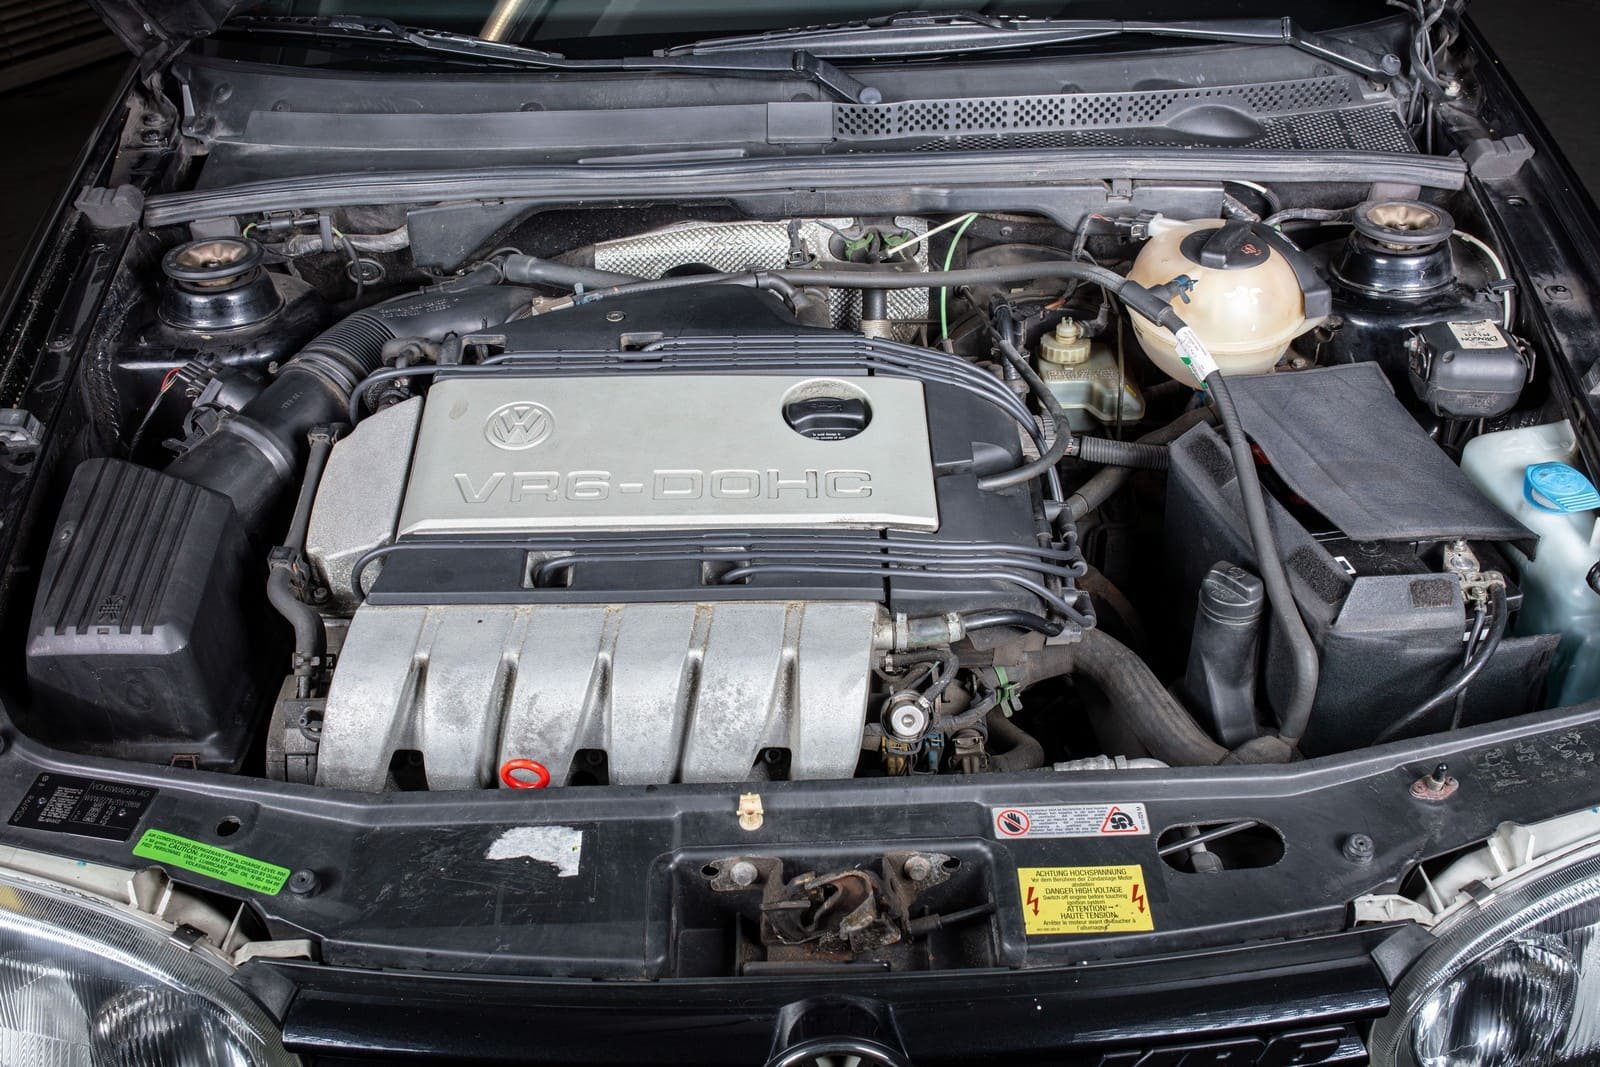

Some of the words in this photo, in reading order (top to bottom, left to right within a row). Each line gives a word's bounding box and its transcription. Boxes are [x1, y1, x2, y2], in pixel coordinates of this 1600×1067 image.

[453, 469, 873, 503] VR6-DOHC
[155, 834, 190, 847] CONDITIONING
[191, 844, 224, 857] REFRIGERANT
[240, 859, 260, 869] CHARGE
[260, 865, 276, 873] LEVEL
[185, 860, 219, 873] VOLKSWAGEN
[199, 852, 220, 862] SYSTEM
[234, 863, 258, 874] SERVICED
